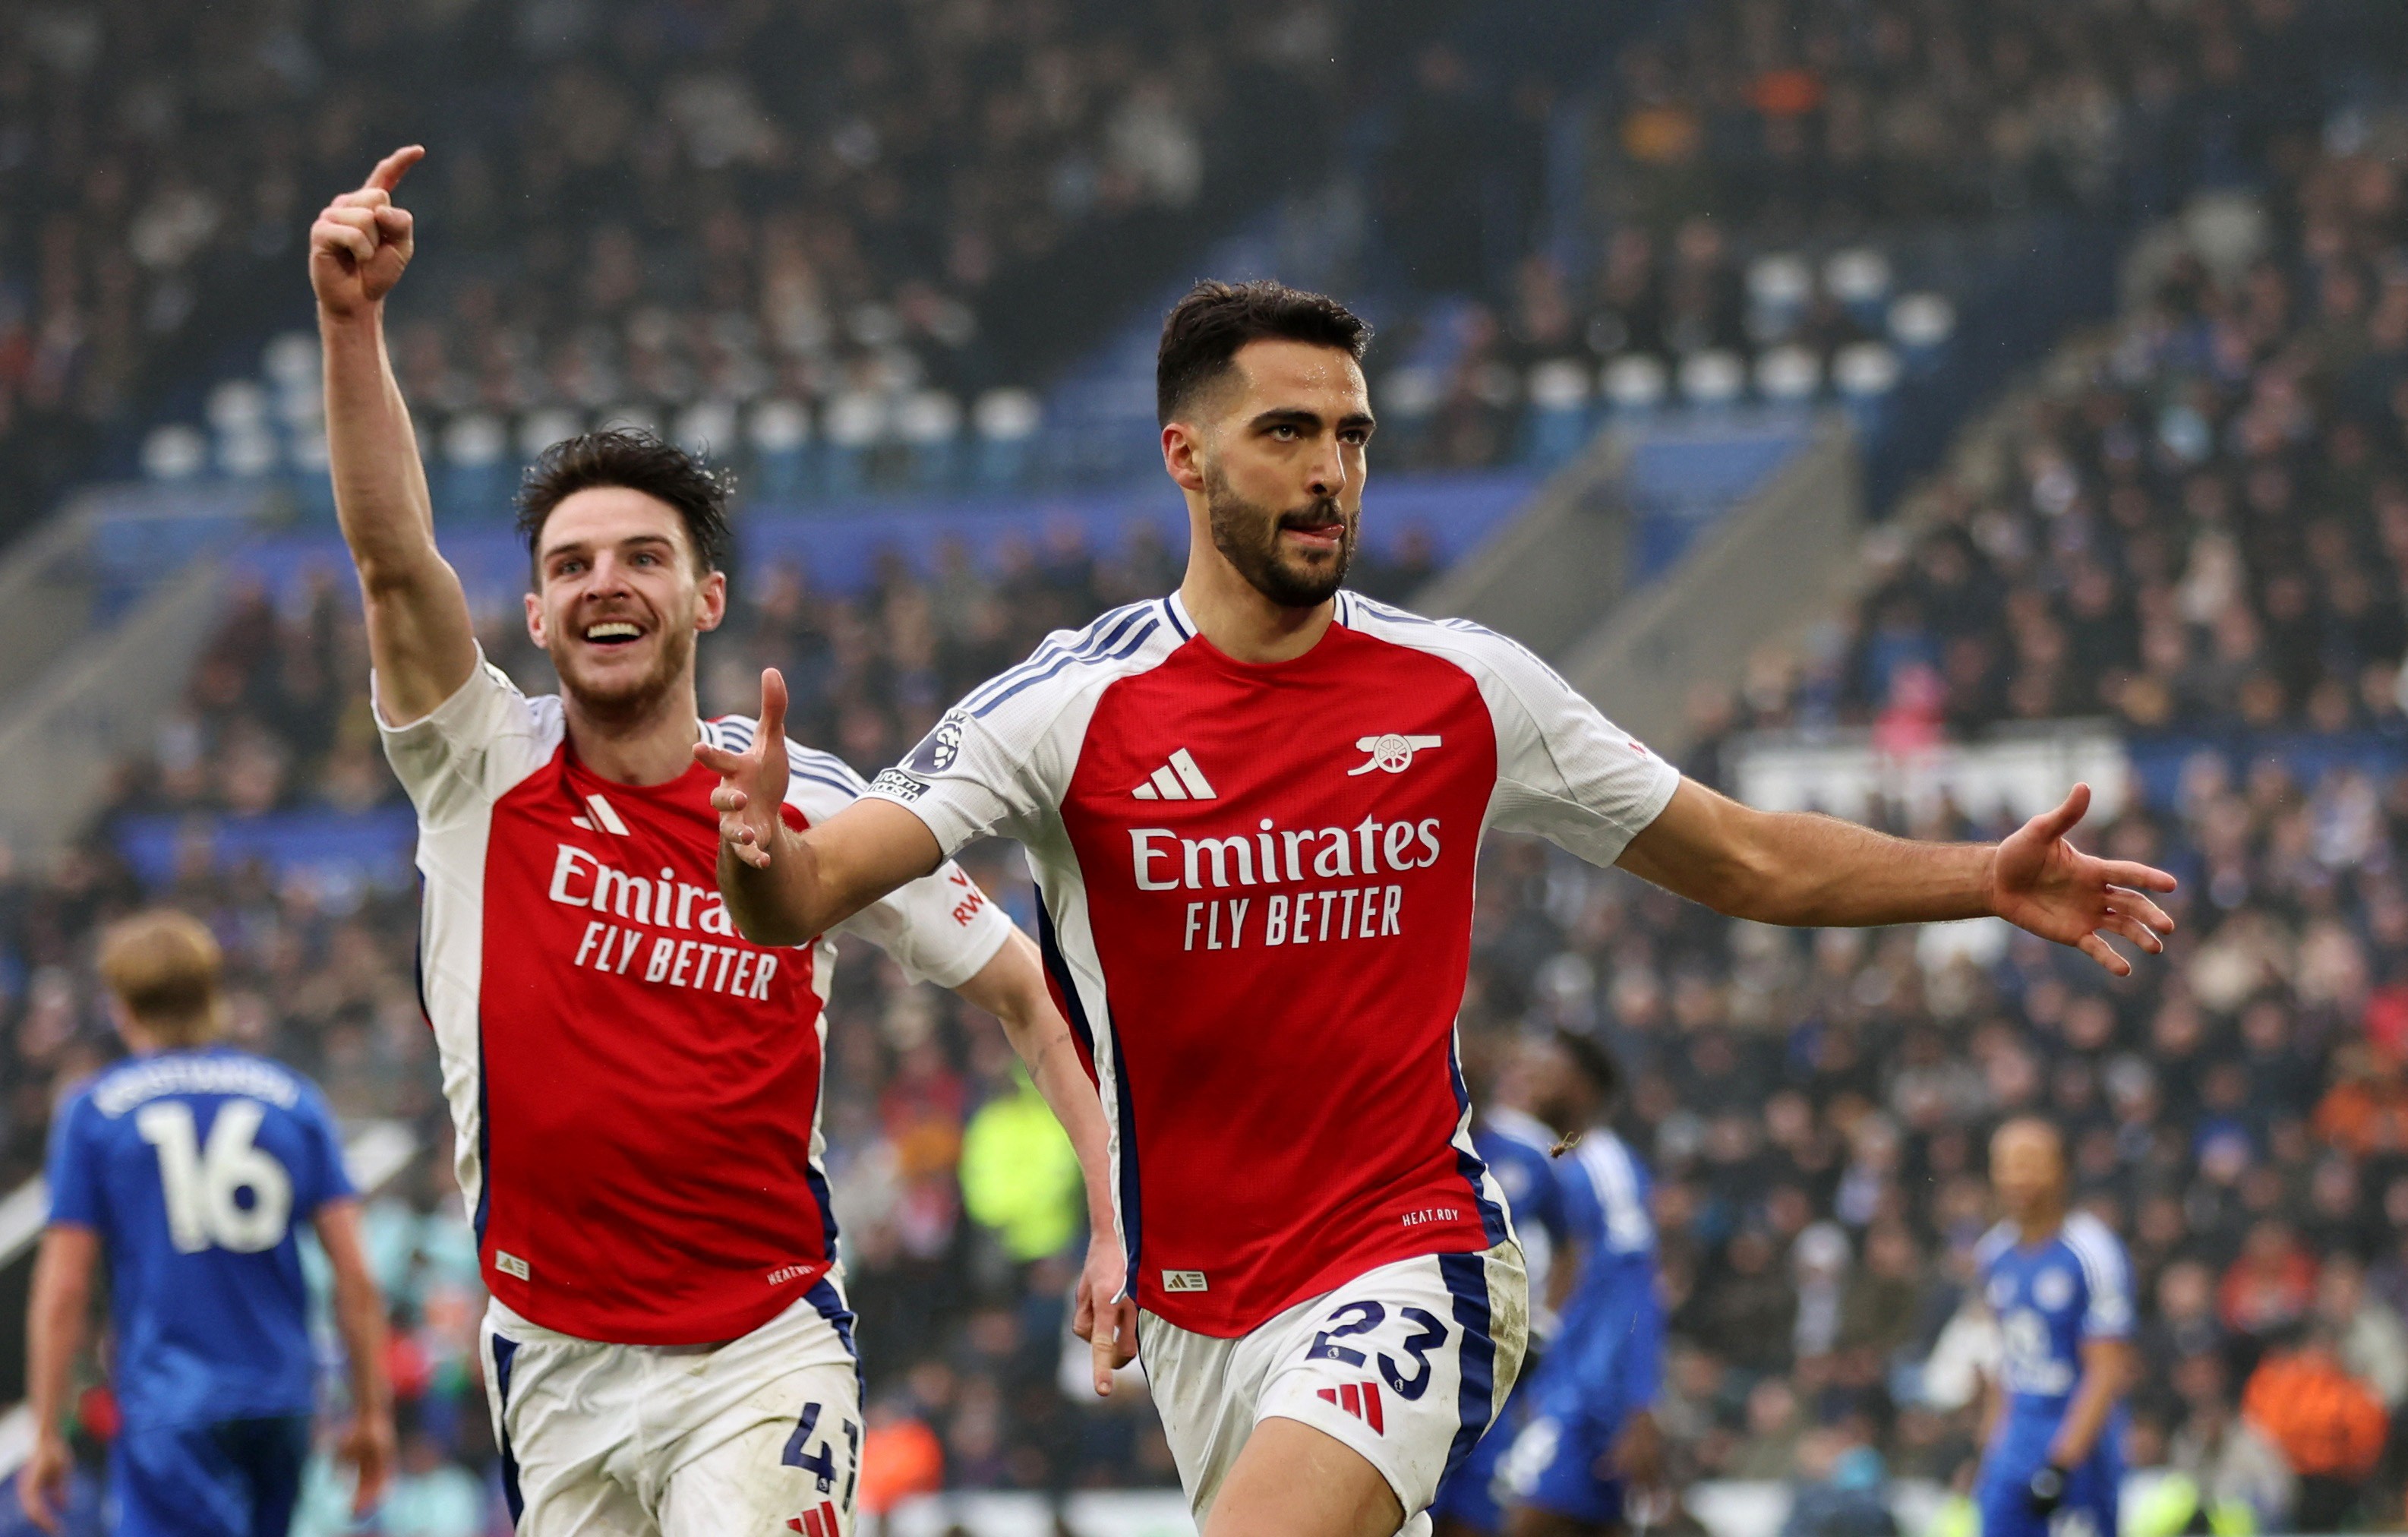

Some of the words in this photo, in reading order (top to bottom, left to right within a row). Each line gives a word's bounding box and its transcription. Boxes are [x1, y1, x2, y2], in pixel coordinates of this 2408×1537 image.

[548, 843, 744, 939] Emira
[1127, 813, 1441, 891] Emirates
[573, 920, 644, 975] FLY
[645, 936, 778, 1001] BETTER
[1184, 898, 1251, 951] FLY
[1265, 885, 1402, 946] BETTER
[135, 1099, 295, 1255] 16
[1304, 1300, 1449, 1401] 23
[781, 1402, 858, 1514] 41
